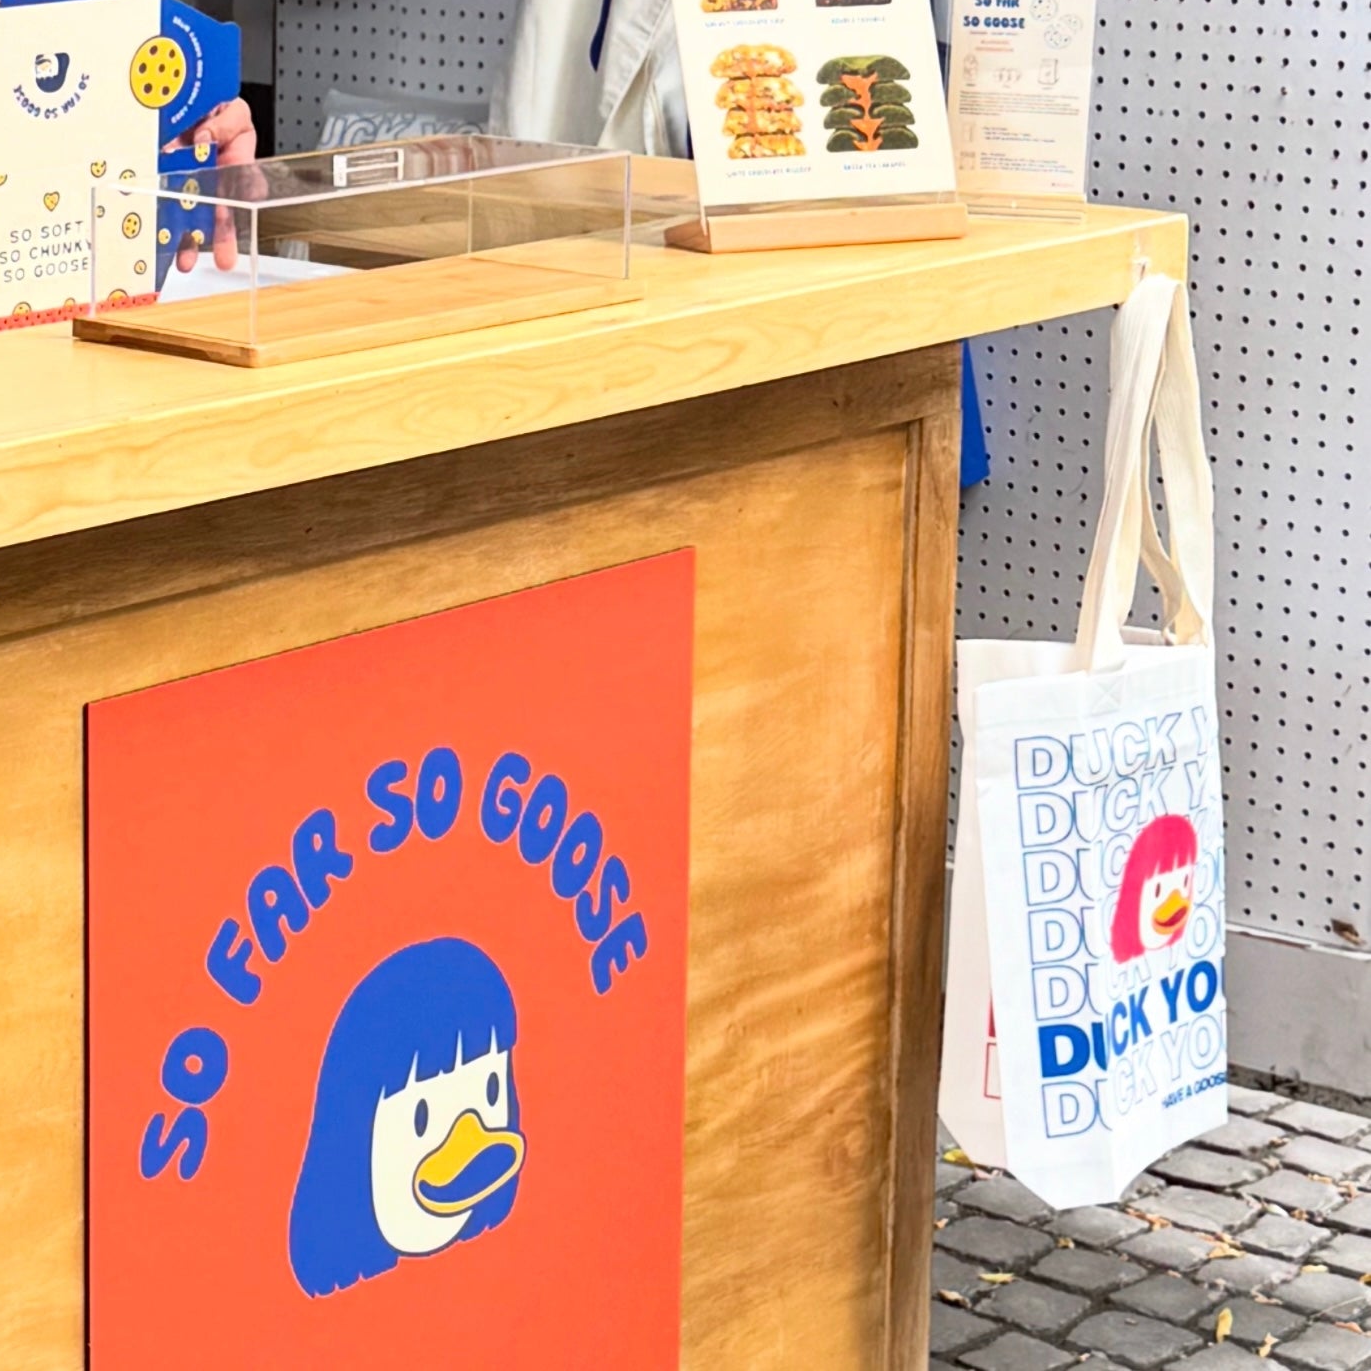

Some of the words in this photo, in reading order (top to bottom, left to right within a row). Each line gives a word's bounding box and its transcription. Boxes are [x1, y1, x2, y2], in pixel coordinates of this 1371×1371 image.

[963, 15, 980, 27] SO
[983, 16, 1025, 29] GOOSE
[0, 250, 21, 265] SO
[10, 229, 32, 244] SO
[3, 268, 25, 283] SO
[1014, 712, 1182, 790] DUCK
[139, 1026, 230, 1182] SO
[205, 807, 354, 1007] FAR
[365, 745, 464, 855] SO
[479, 751, 649, 996] GOOSE
[1038, 985, 1153, 1079] DUCK
[1160, 959, 1226, 1025] YO
[1160, 1010, 1226, 1082] YO
